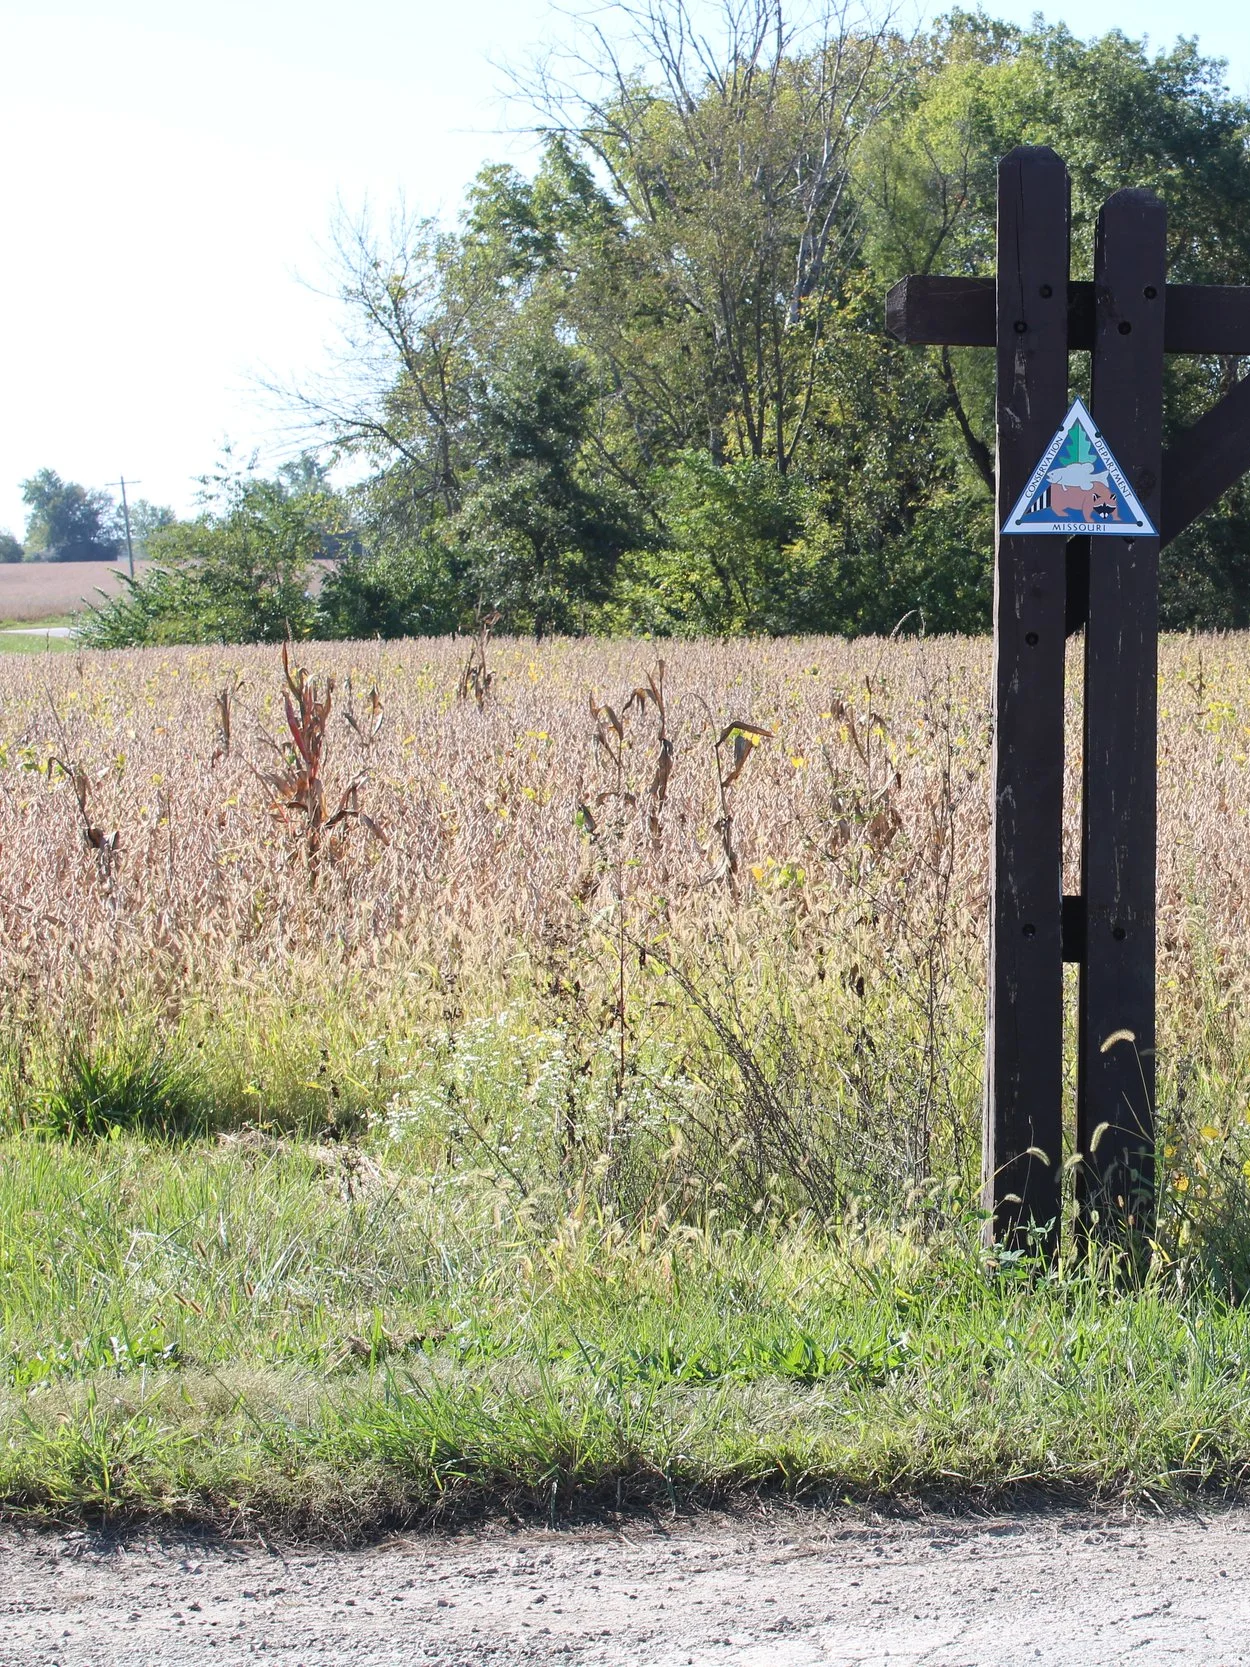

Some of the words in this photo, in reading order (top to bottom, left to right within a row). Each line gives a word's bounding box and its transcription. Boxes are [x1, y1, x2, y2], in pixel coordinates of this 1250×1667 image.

[1025, 437, 1063, 498] CONSERVATION
[1094, 440, 1132, 498] DEPARTMENT
[1052, 523, 1106, 532] MISSOURI
